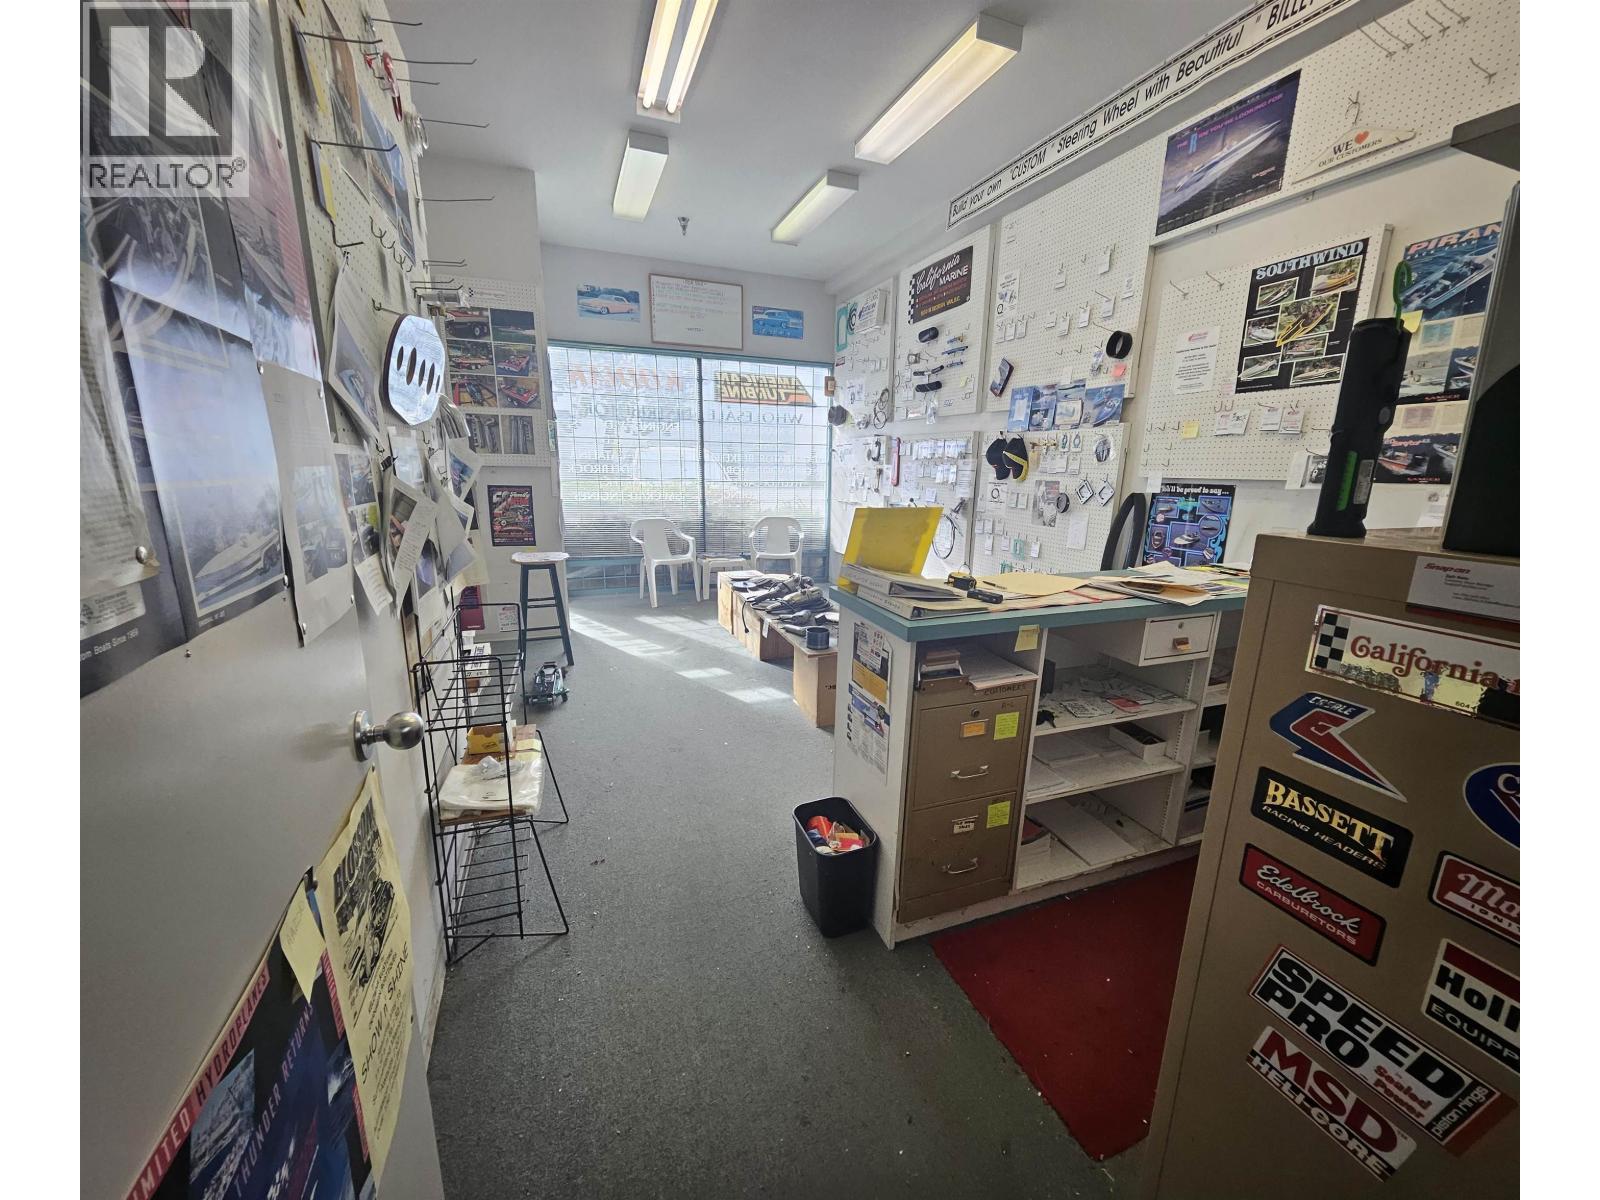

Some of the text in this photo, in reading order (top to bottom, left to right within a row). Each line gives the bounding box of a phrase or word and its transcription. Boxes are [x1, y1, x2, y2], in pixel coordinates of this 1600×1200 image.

[1057, 119, 1098, 153] Steering
[1103, 97, 1138, 128] Wheel
[1145, 74, 1169, 102] with
[1176, 25, 1244, 83] Beautiful
[1318, 137, 1383, 168] OUR CUSTOMERS
[1333, 139, 1353, 156] WE
[915, 254, 961, 295] California
[938, 264, 969, 286] MARINE
[1255, 241, 1364, 281] SOUTHWIND
[94, 643, 112, 656] Boats
[1350, 635, 1500, 689] California
[1262, 804, 1388, 871] RACING HEADERS
[1263, 778, 1395, 861] BASSETT
[1256, 880, 1357, 946] CARBURETORS
[1257, 864, 1362, 934] Edelbrock
[196, 966, 270, 1107] HYDROPLANES
[361, 1017, 383, 1085] SHOW
[387, 941, 410, 993] SHINE
[1257, 978, 1370, 1069] PRO
[1272, 957, 1466, 1099] SPEED
[234, 1003, 315, 1198] THUNDER RETURNS
[1260, 1030, 1398, 1153] MSD
[1373, 1079, 1425, 1119] Power
[1374, 1064, 1432, 1110] Sealed
[1457, 1086, 1489, 1113] rings
